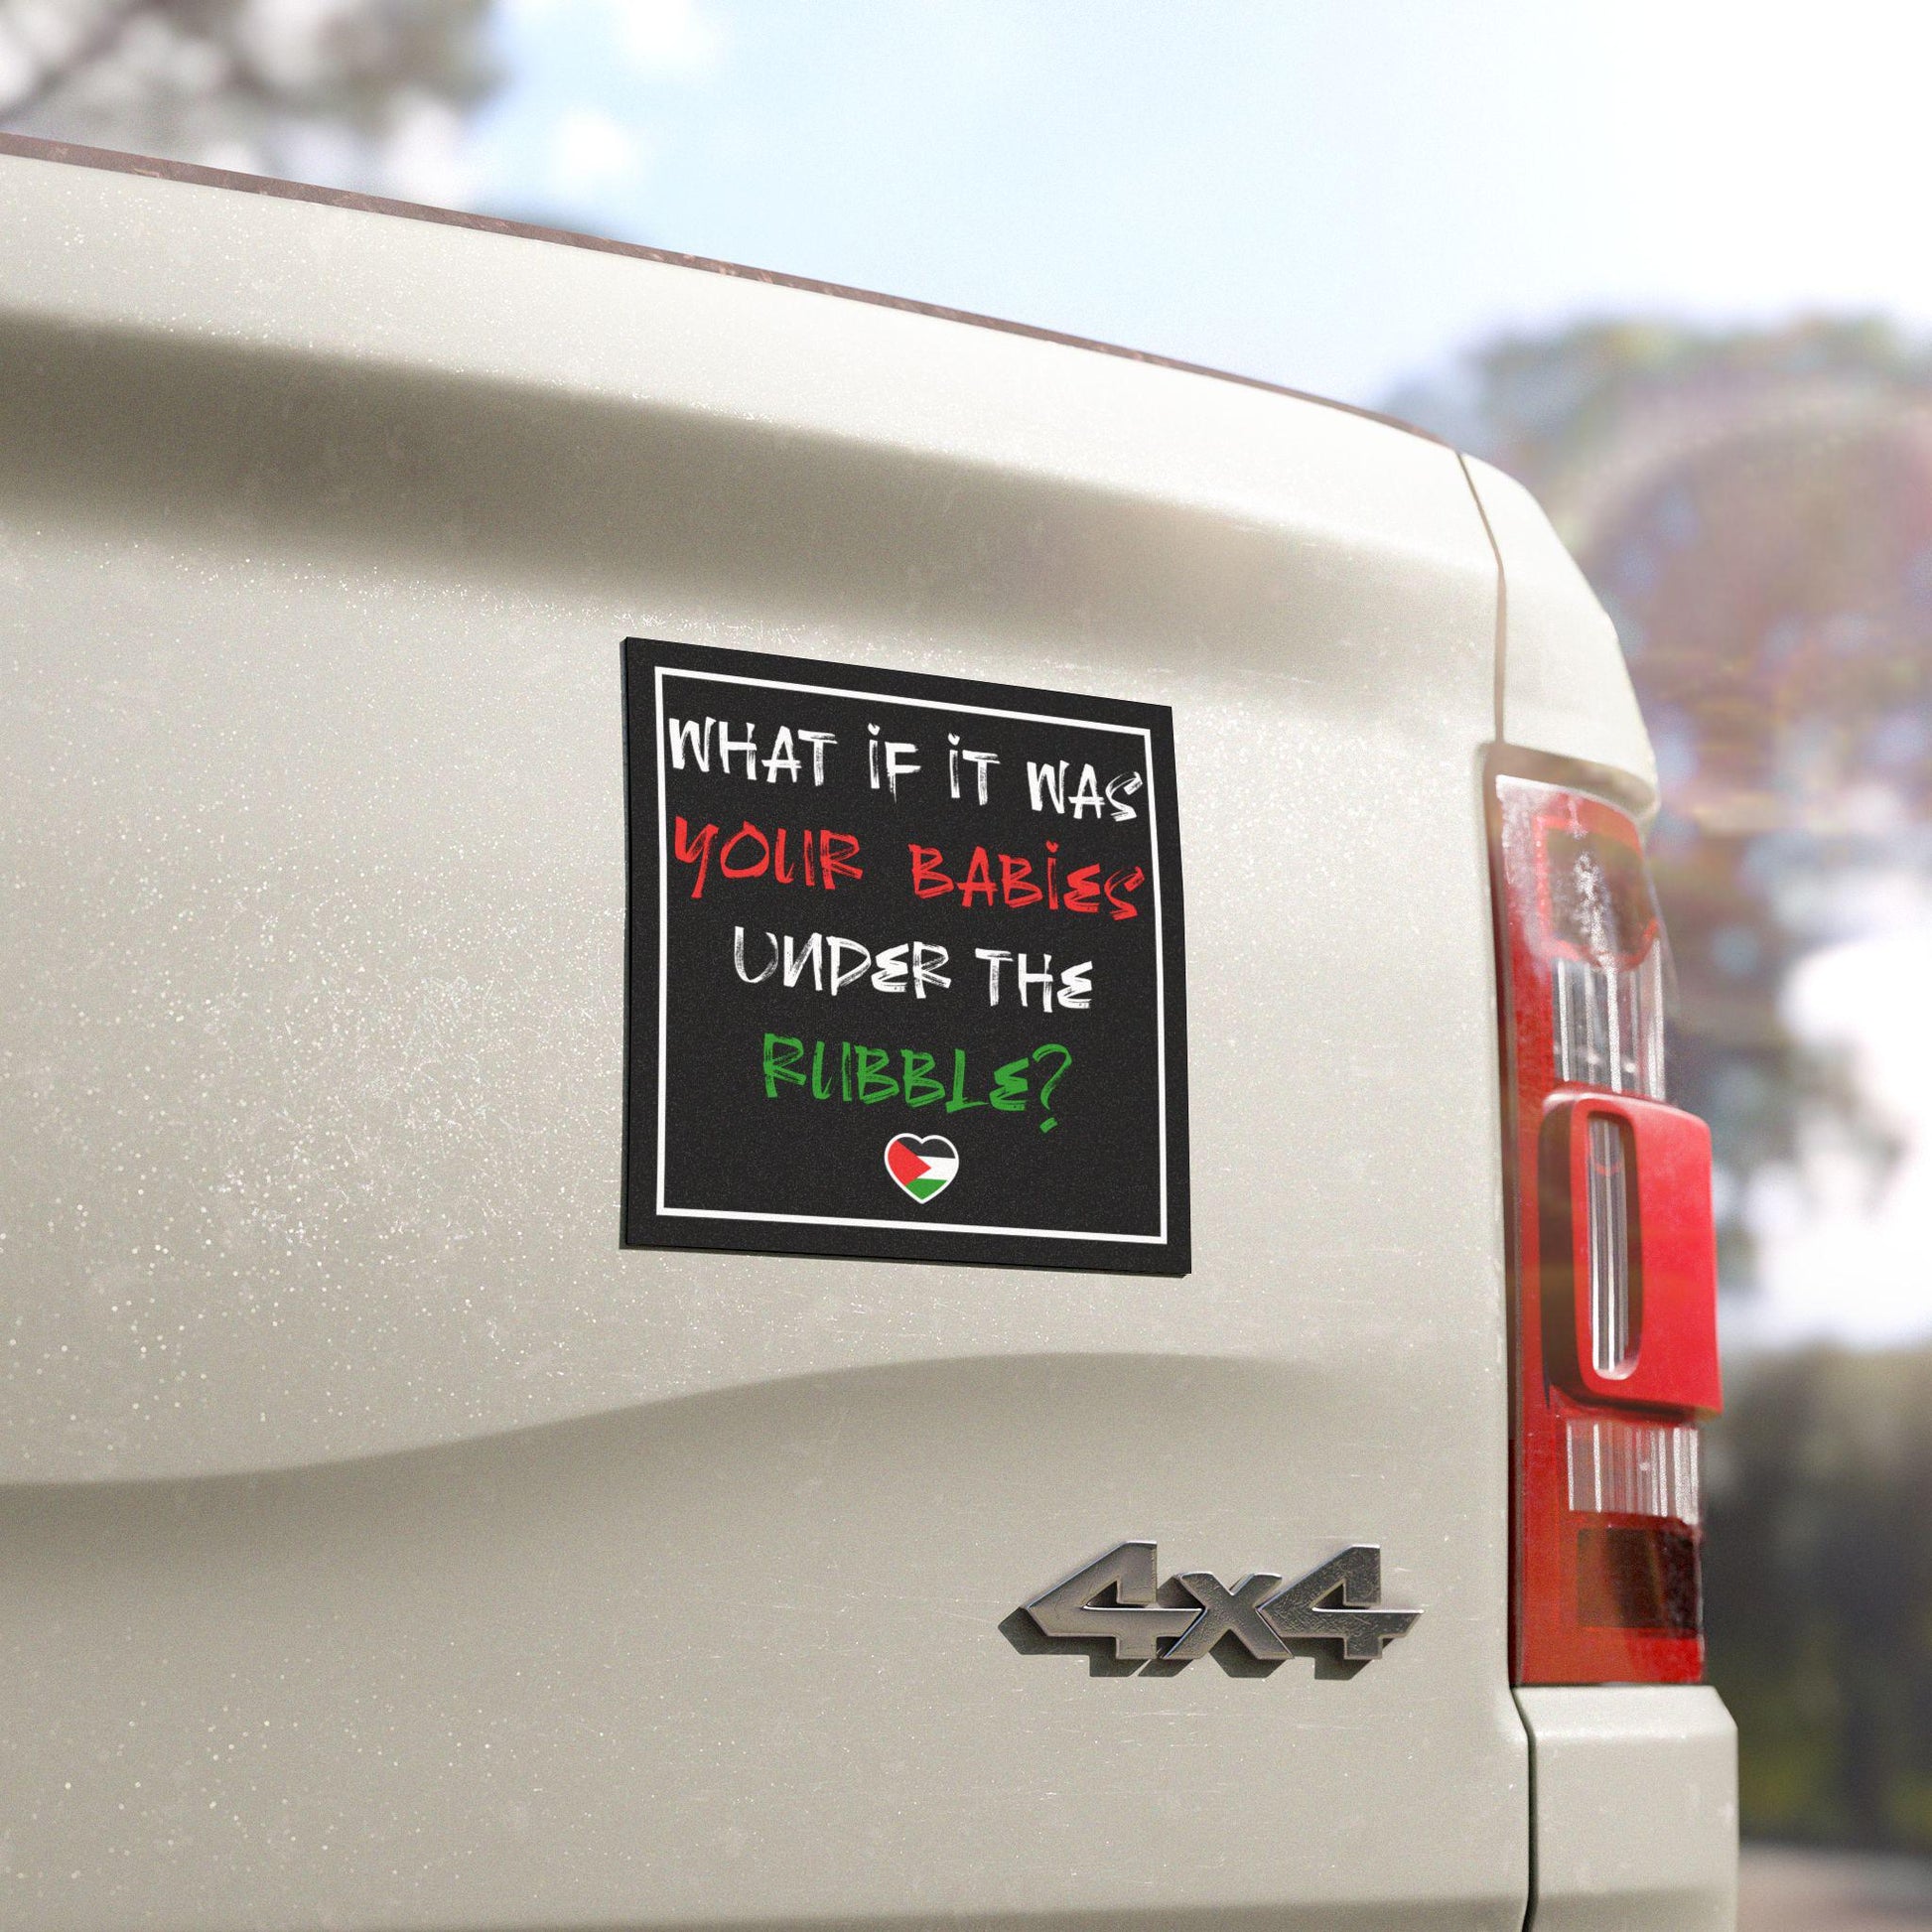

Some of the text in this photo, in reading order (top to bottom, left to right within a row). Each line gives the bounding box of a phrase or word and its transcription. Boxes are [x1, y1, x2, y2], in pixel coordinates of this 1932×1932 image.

[669, 716, 838, 786] WHAT
[1027, 760, 1143, 822] WAS
[674, 816, 863, 898] YOUR
[734, 925, 1094, 1013] UNDER THE
[763, 1033, 1072, 1133] RUBBLE?
